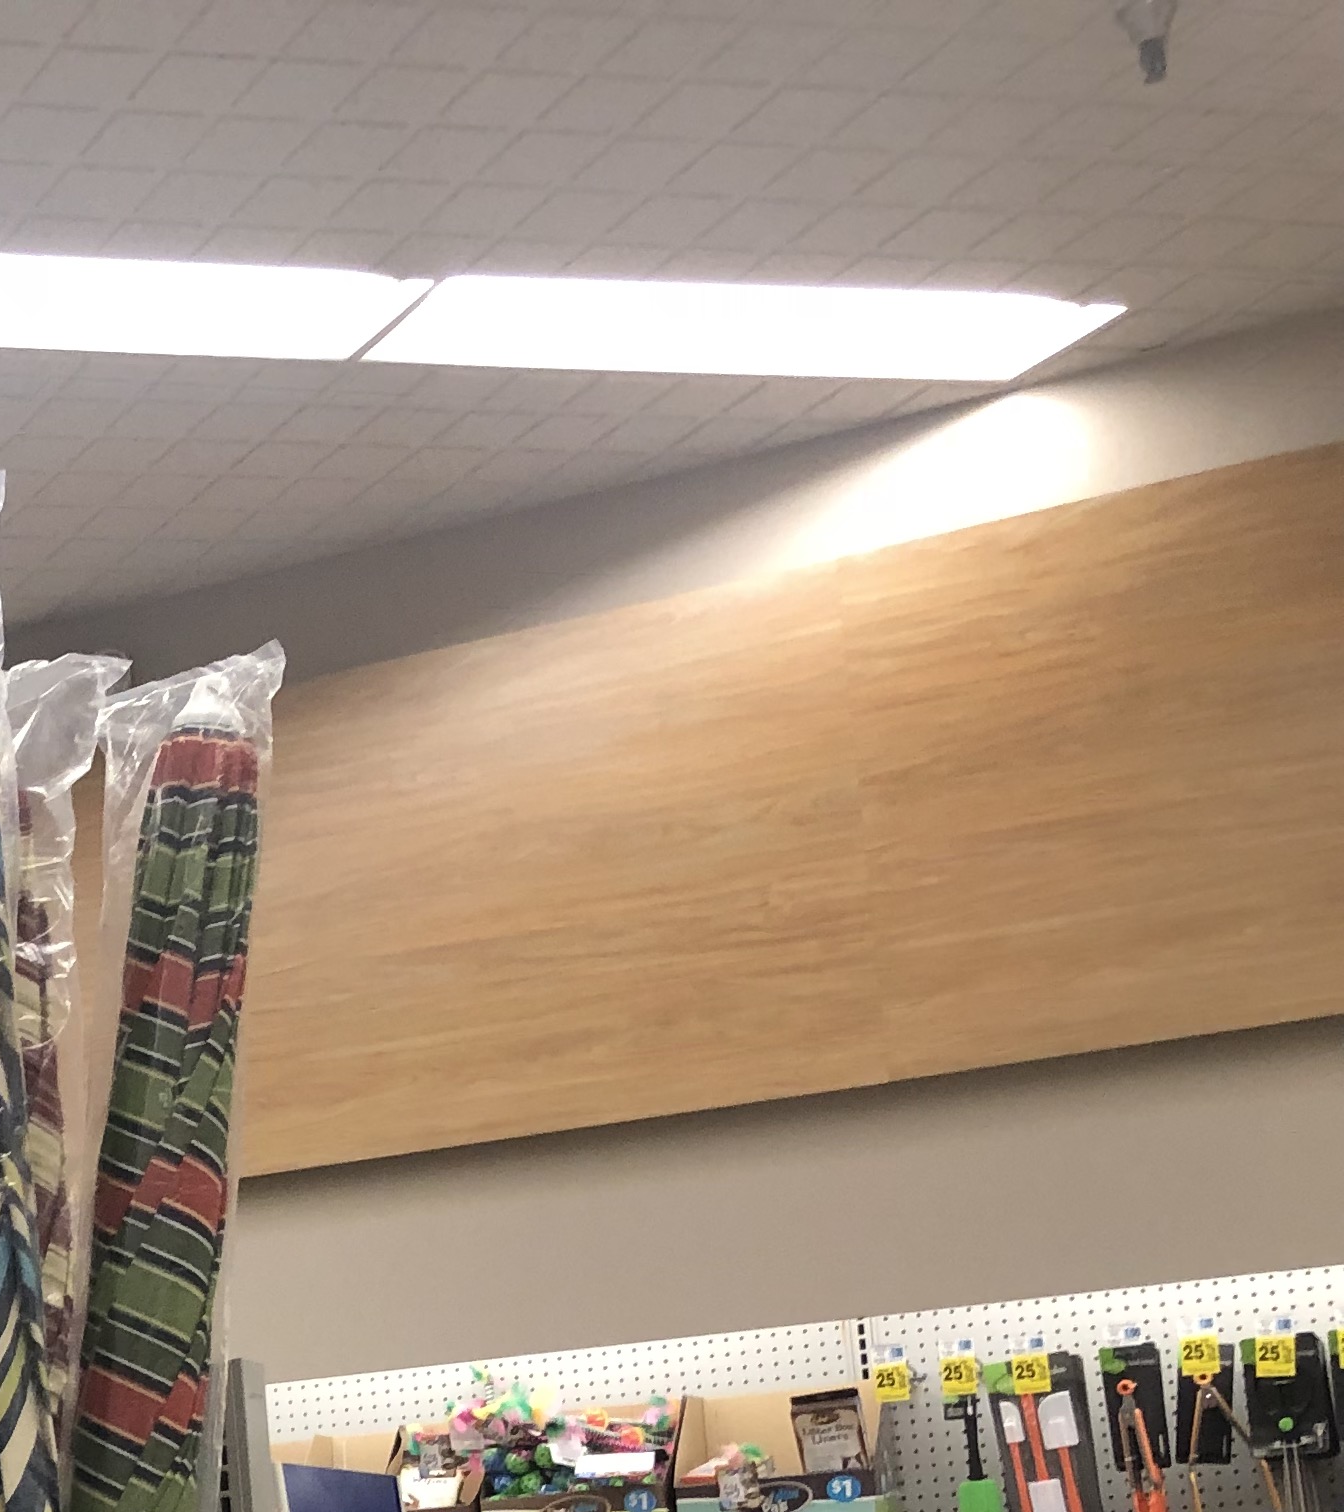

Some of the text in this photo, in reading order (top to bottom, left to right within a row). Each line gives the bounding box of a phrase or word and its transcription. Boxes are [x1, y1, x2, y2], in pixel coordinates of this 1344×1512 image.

[1183, 1344, 1205, 1361] 25
[1258, 1344, 1281, 1363] 25
[876, 1372, 897, 1389] 25
[943, 1365, 964, 1382] 25
[1015, 1364, 1036, 1381] 25
[830, 1478, 853, 1499] $1
[626, 1491, 649, 1512] $1
